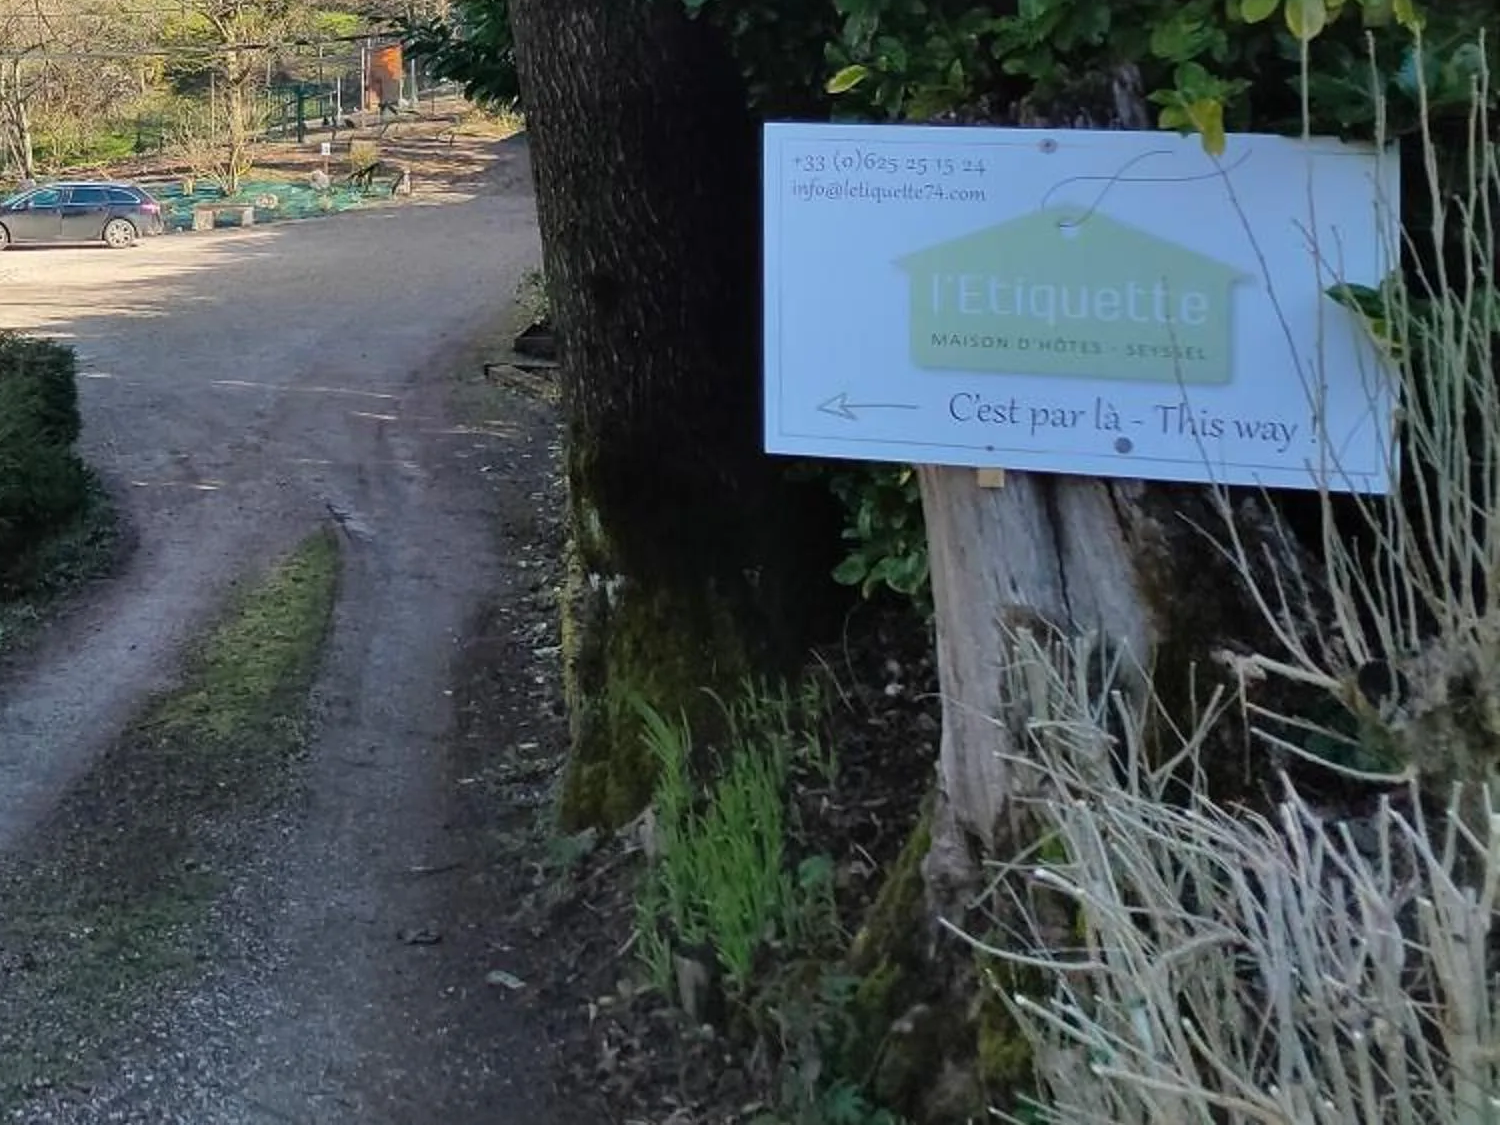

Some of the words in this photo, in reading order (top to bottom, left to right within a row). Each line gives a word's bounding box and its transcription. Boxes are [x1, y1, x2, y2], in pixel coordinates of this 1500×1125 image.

[793, 152, 826, 172] +33
[833, 148, 898, 174] (0)625
[906, 156, 928, 175] 25
[935, 156, 954, 176] 15
[962, 156, 987, 177] 24
[792, 178, 987, 203] info@letiquette74.com
[932, 273, 1209, 326] l'Etiquette
[931, 332, 1009, 349] MAISON
[1017, 335, 1101, 355] D'HÔTES
[1125, 343, 1206, 361] SEYSSEL
[948, 391, 1020, 425] C'est
[1030, 406, 1086, 436] par
[1094, 396, 1123, 431] là
[1154, 401, 1225, 438] This
[1233, 419, 1299, 453] way
